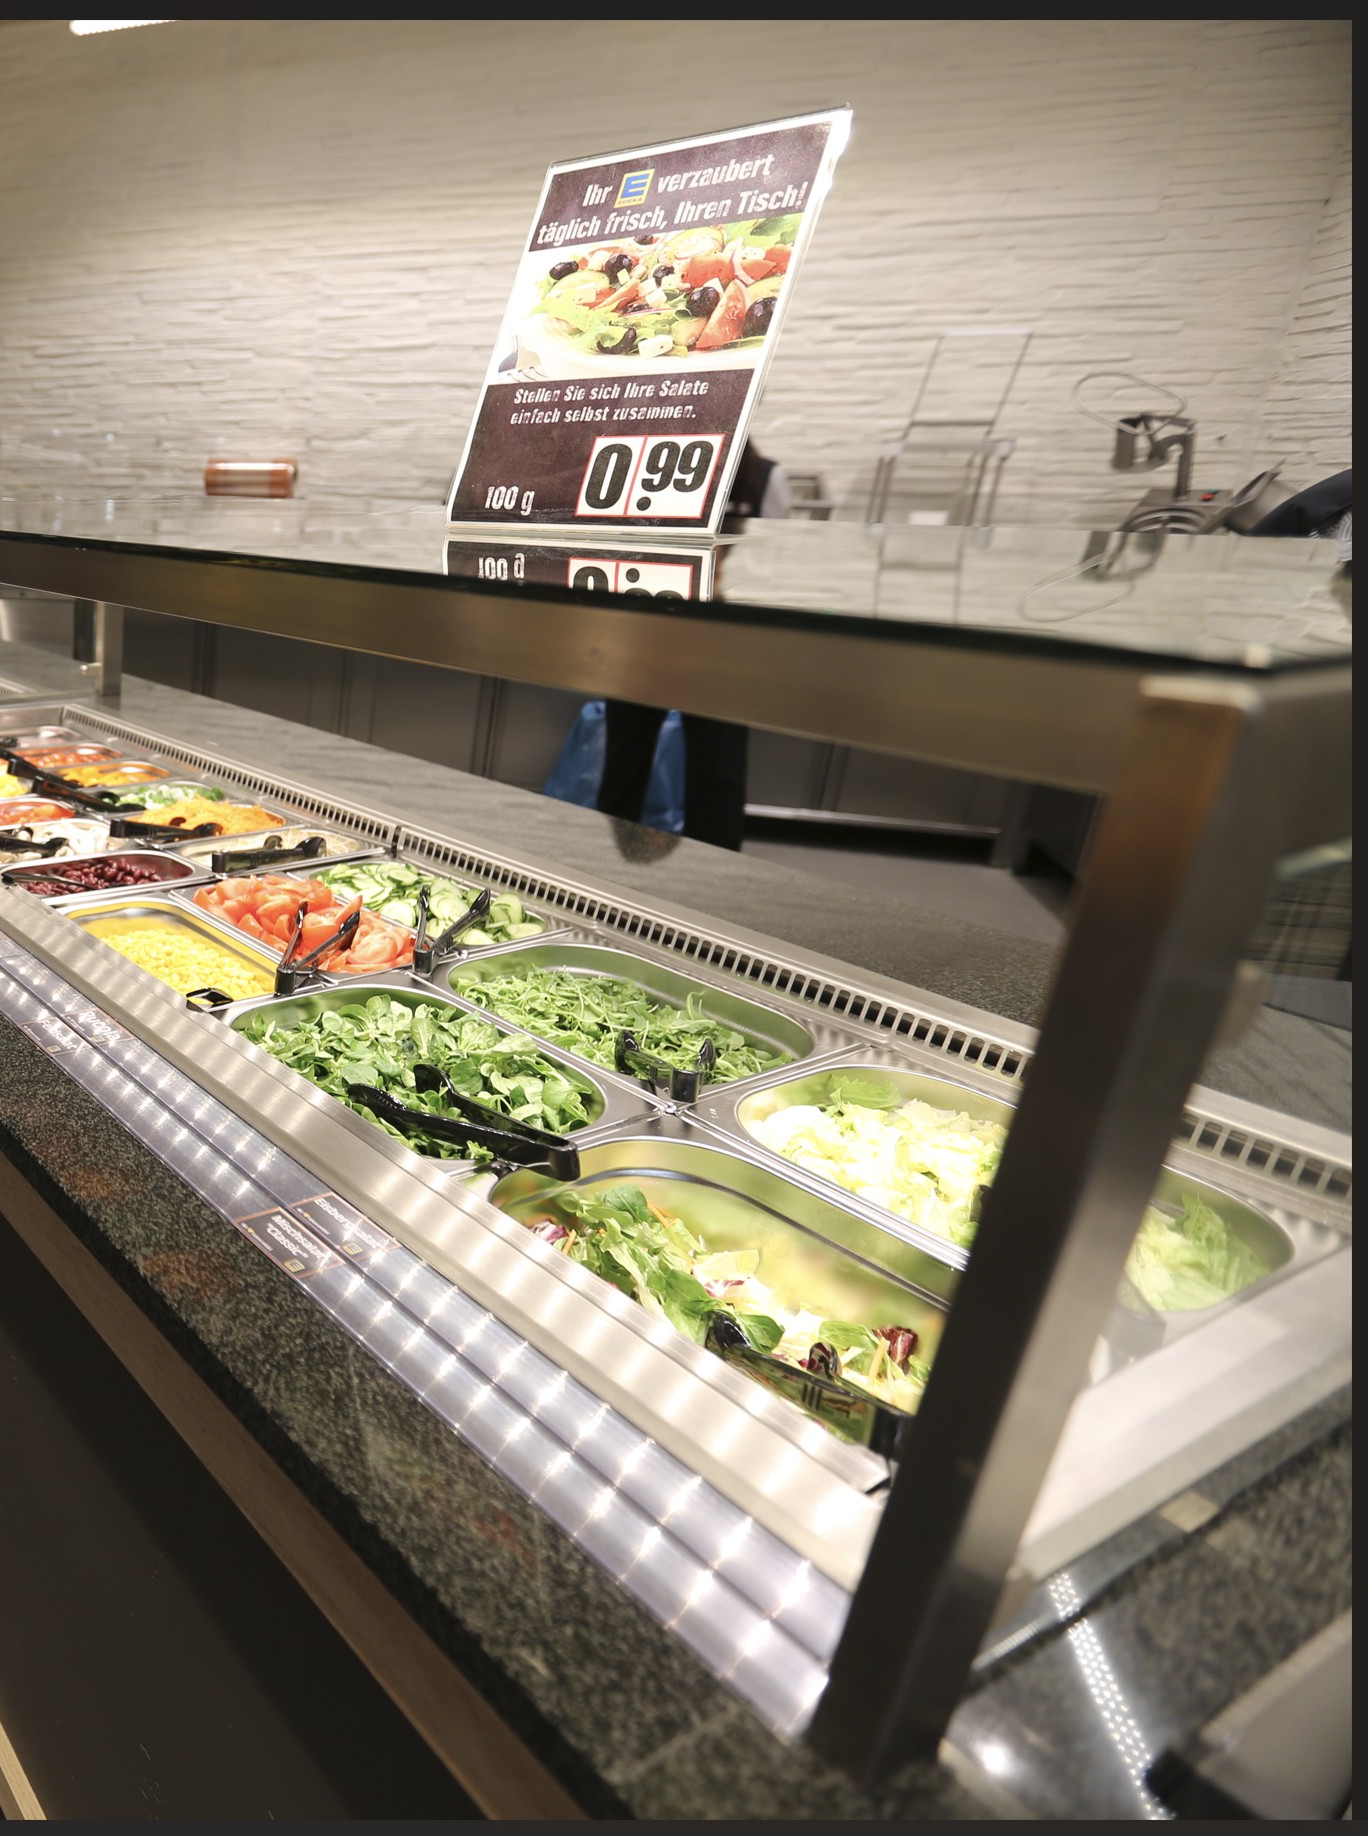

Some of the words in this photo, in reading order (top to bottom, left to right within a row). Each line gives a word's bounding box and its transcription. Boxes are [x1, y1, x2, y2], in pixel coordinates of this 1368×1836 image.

[582, 184, 613, 207] Ihr
[658, 154, 775, 194] verzaubert
[537, 215, 601, 246] täglich
[604, 206, 668, 235] frisch,
[674, 199, 731, 225] Ihren
[737, 181, 808, 215] Tisch!
[513, 388, 561, 404] Stellen
[564, 385, 586, 402] Sie
[589, 383, 621, 400] sich
[623, 382, 656, 399] Ihre
[659, 380, 709, 397] Salate
[510, 408, 560, 425] einfach
[564, 406, 609, 423] selbst
[612, 405, 697, 421] zusammen.
[484, 485, 519, 510] 100
[520, 489, 536, 517] g
[78, 1011, 120, 1041] Rucola
